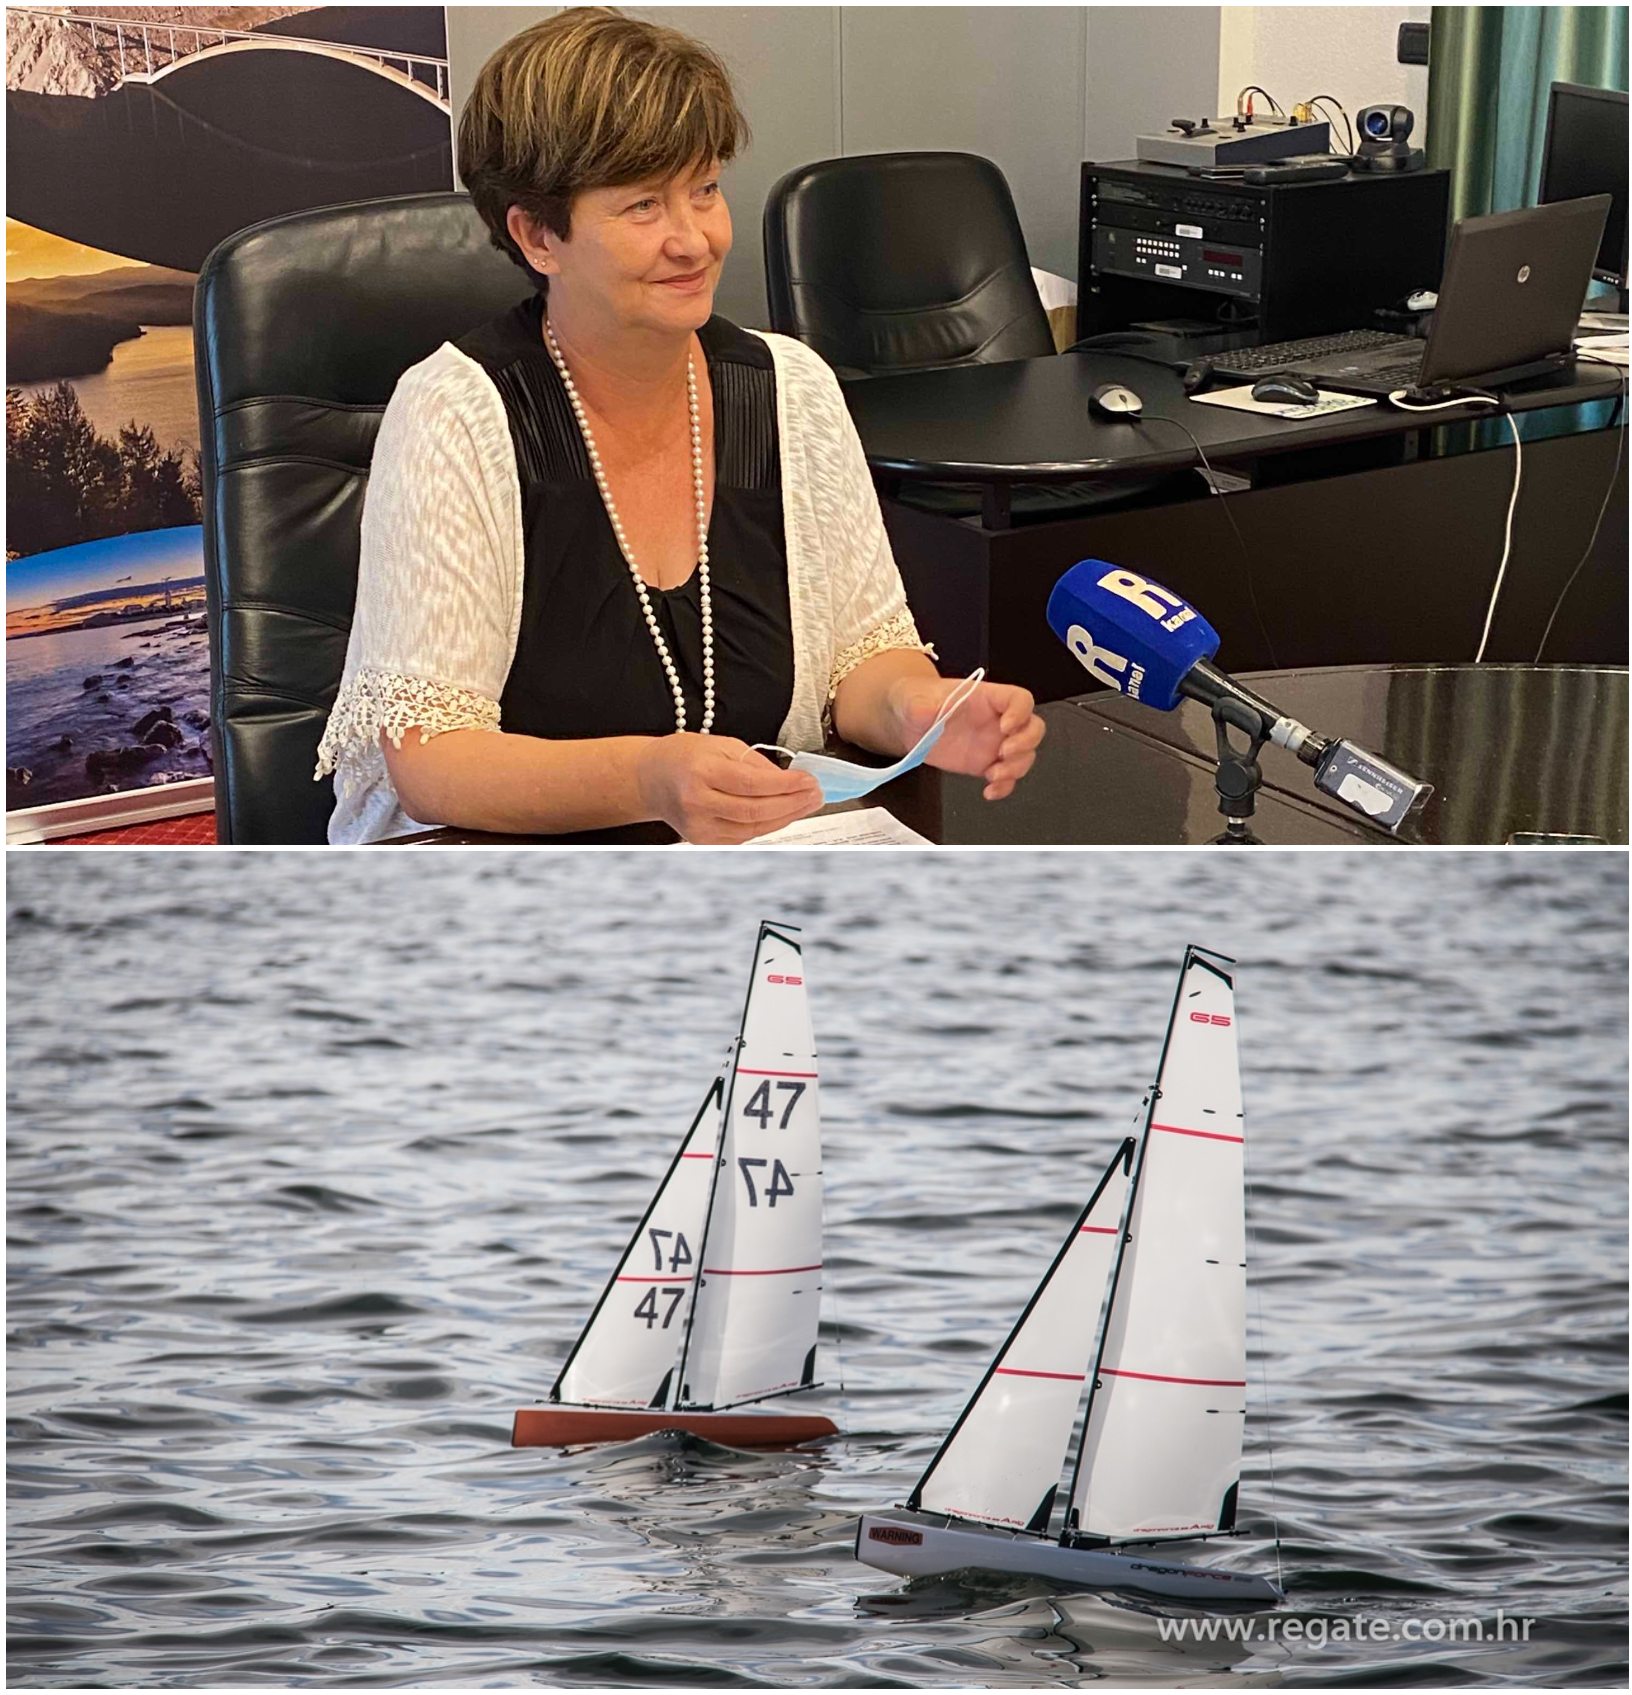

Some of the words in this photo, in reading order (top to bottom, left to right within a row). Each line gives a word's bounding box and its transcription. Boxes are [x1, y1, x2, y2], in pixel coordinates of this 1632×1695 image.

[743, 1079, 807, 1130] 47
[633, 1286, 686, 1329] 47
[871, 1528, 921, 1544] WARNING
